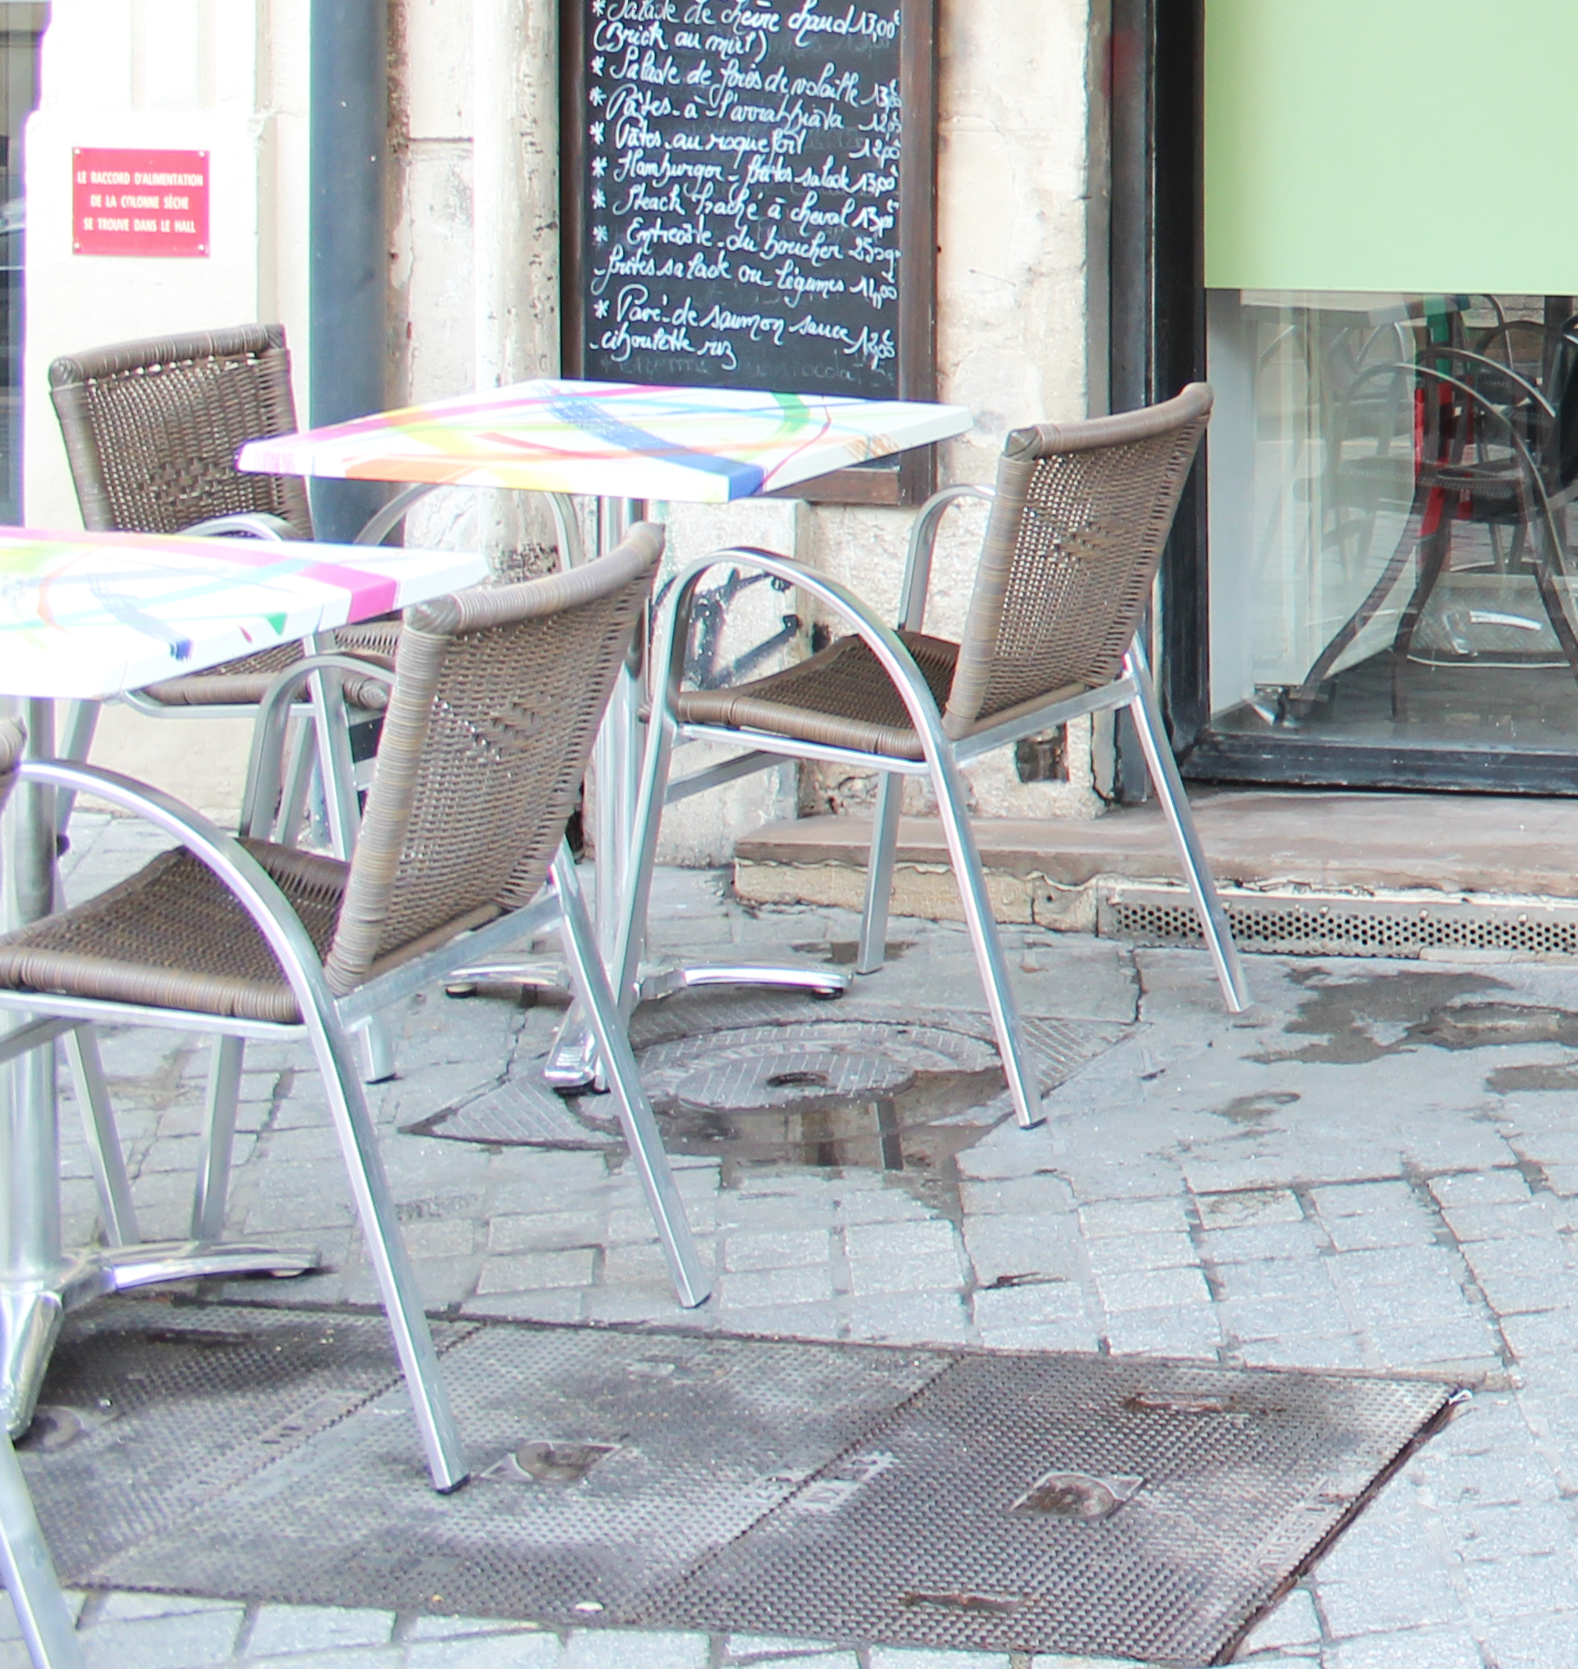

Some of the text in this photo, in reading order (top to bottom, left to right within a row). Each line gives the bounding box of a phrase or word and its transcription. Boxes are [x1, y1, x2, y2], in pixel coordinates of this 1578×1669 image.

[684, 1, 716, 25] de
[675, 33, 701, 51] au
[610, 45, 681, 86] Salade
[686, 59, 713, 86] de
[791, 62, 861, 108] volaille
[605, 83, 672, 122] Pâtes
[615, 113, 662, 151] Pâtes
[672, 131, 703, 152] au
[77, 171, 204, 187] LE RACCORD D'ALIMENTATION
[613, 148, 726, 197] Hamburger
[90, 193, 190, 210] DE LA COLONNE SÈCHE
[790, 190, 855, 237] cheval
[83, 217, 197, 233] SE TROUVE DANS LE HALL
[725, 225, 759, 253] du
[760, 224, 843, 268] boucher
[738, 265, 773, 287] ou
[672, 296, 699, 327] de
[699, 305, 785, 346] saumon
[789, 315, 852, 344] sauce
